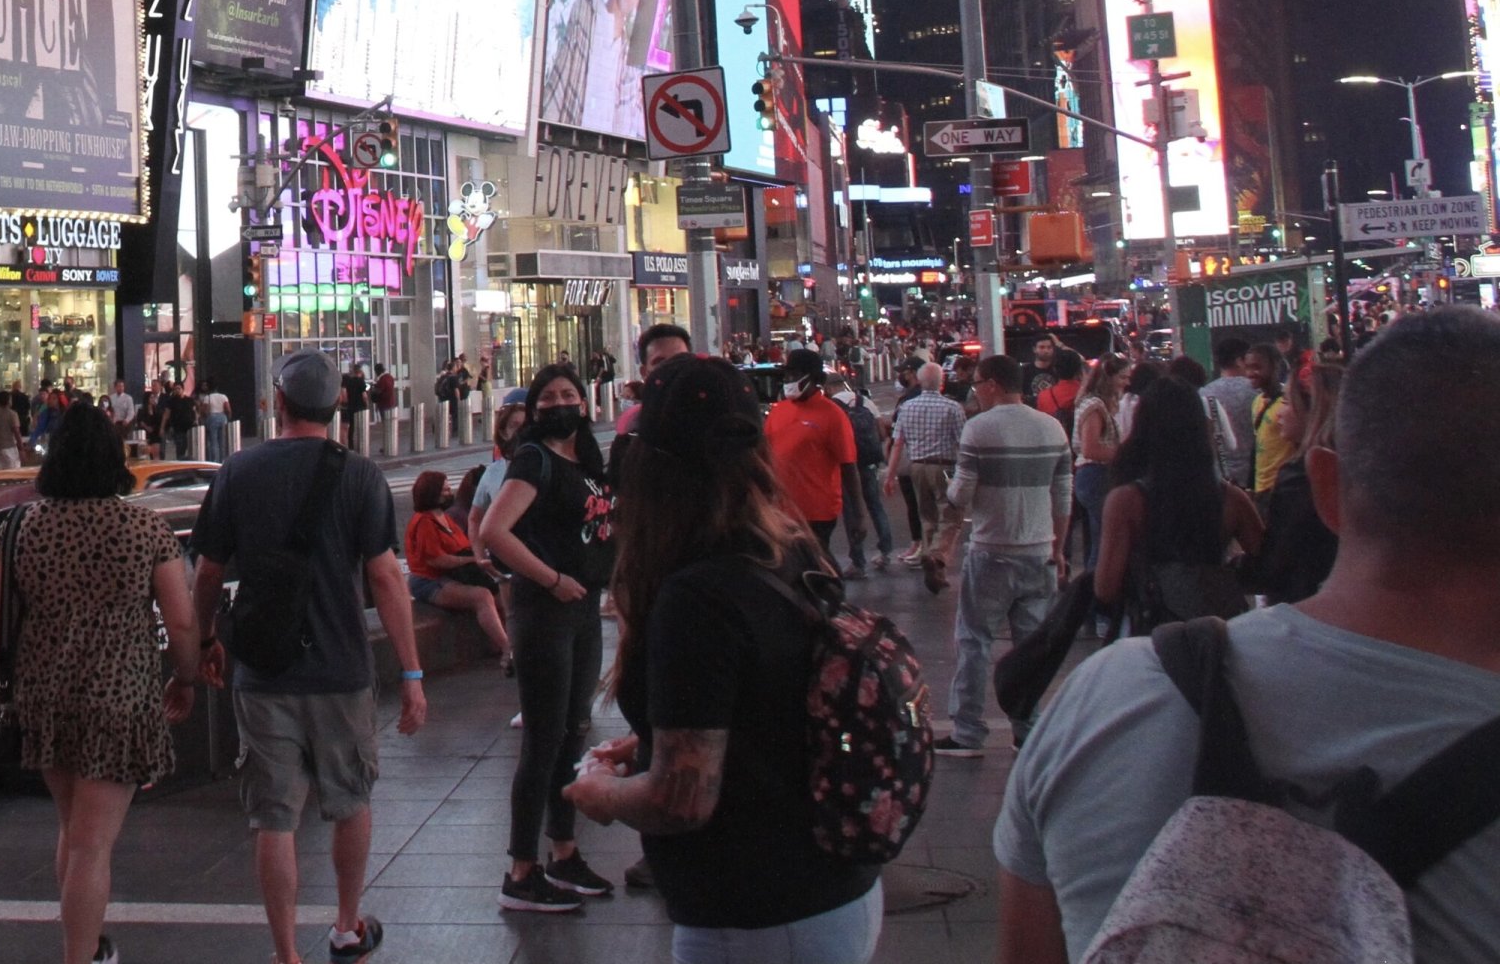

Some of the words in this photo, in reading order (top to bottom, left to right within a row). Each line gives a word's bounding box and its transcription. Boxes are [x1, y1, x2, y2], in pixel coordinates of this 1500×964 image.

[227, 1, 280, 27] @InsurEarth
[1143, 19, 1156, 28] TO
[1143, 30, 1157, 40] 45
[940, 131, 970, 144] ONE
[983, 129, 1015, 143] WAY
[533, 144, 629, 225] FOREVER
[680, 196, 703, 204] Times
[704, 195, 733, 204] Square
[1357, 204, 1418, 219] PEDESTRIAN
[1421, 203, 1447, 215] FLOW
[1451, 201, 1477, 213] ZONE
[264, 227, 279, 235] WAY
[1411, 219, 1437, 231] KEEP
[1440, 216, 1479, 229] MOVING
[36, 217, 121, 249] LUGGAGE
[44, 247, 63, 264] NY
[644, 256, 656, 272] U.S.
[656, 257, 673, 272] POLO
[673, 257, 688, 273] ASS
[1222, 257, 1230, 275] 2
[26, 268, 58, 282] Canon
[62, 269, 92, 282] SONY
[96, 270, 119, 282] BOWER
[726, 261, 750, 286] sunglass
[750, 262, 759, 280] hut
[1207, 280, 1297, 306] ISCOVER
[1208, 296, 1298, 327] OADWAY'S
